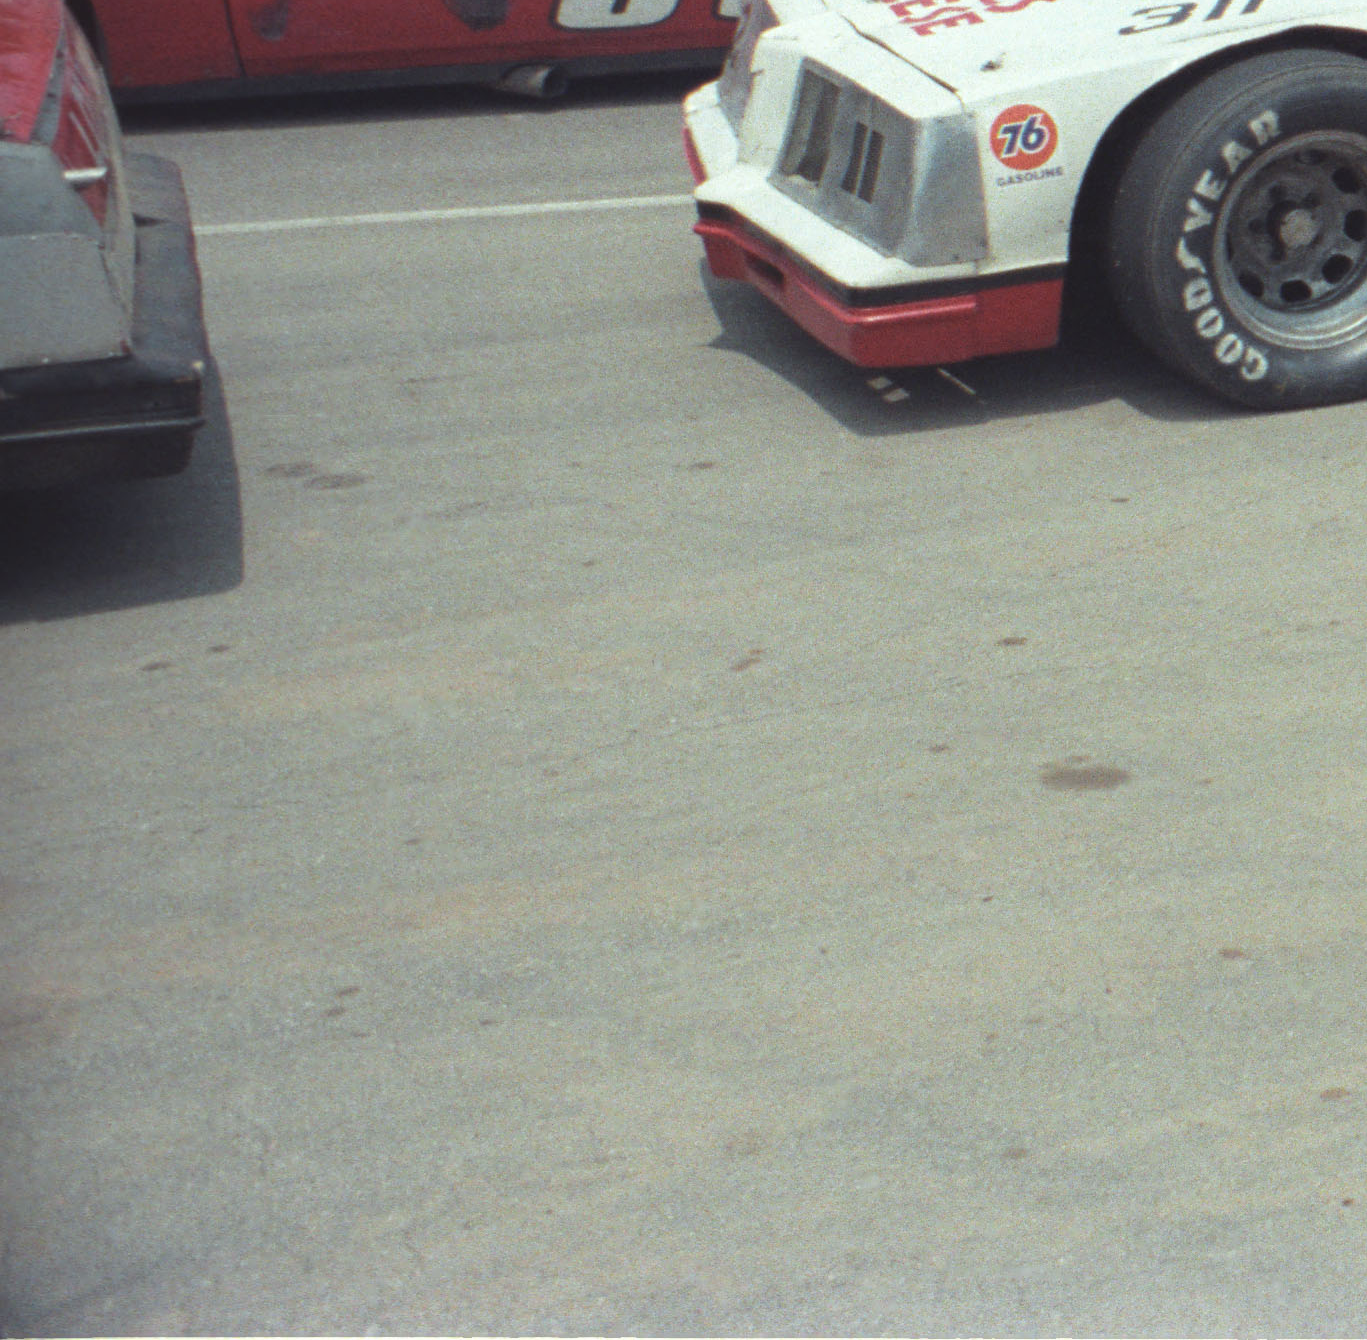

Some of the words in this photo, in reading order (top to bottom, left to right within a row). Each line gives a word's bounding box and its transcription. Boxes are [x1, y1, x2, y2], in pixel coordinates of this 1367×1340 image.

[997, 112, 1050, 158] 76
[996, 166, 1064, 188] GASOLINE
[1176, 109, 1282, 382] GOODYEAR
